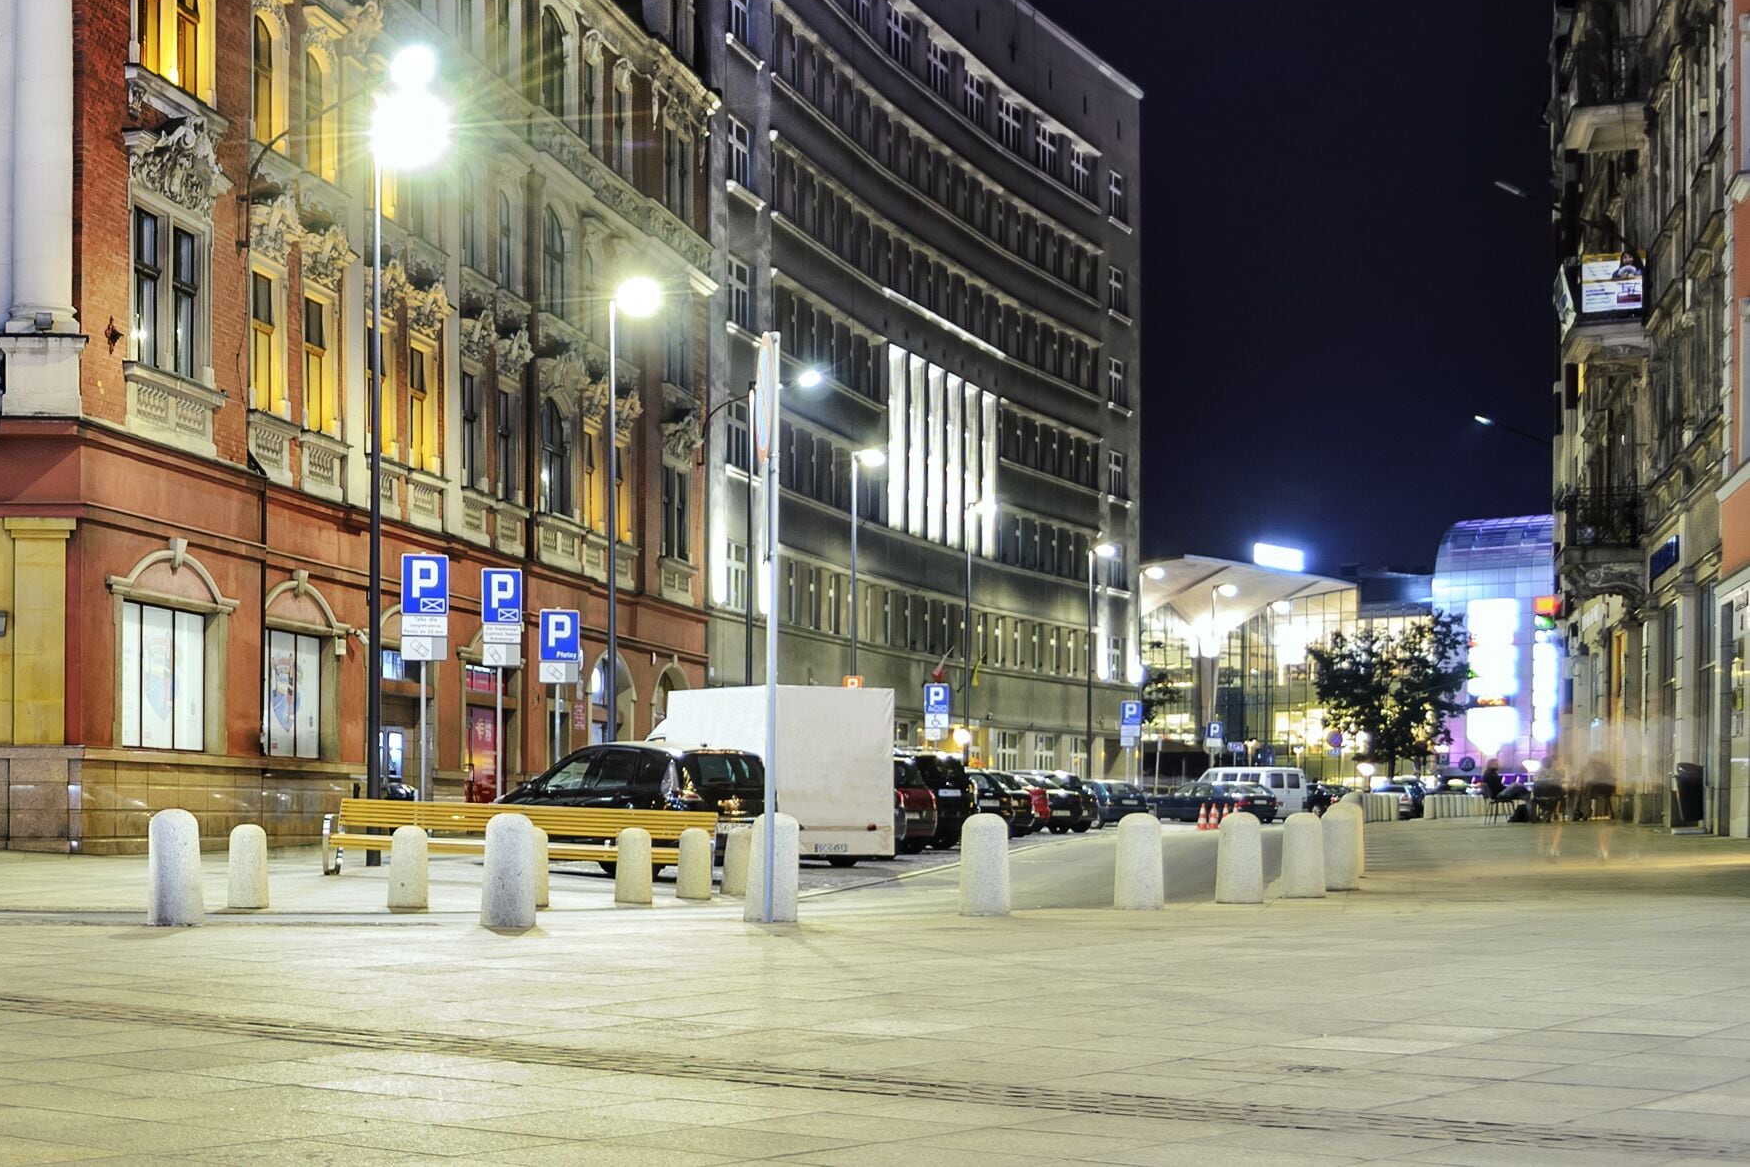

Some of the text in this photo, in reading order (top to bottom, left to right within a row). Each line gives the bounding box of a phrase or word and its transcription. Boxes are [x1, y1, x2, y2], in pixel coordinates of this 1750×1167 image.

[412, 559, 438, 598] P
[491, 573, 515, 609] P
[548, 614, 571, 647] P
[929, 686, 945, 706] P
[1125, 703, 1137, 719] P
[1210, 723, 1220, 737] P
